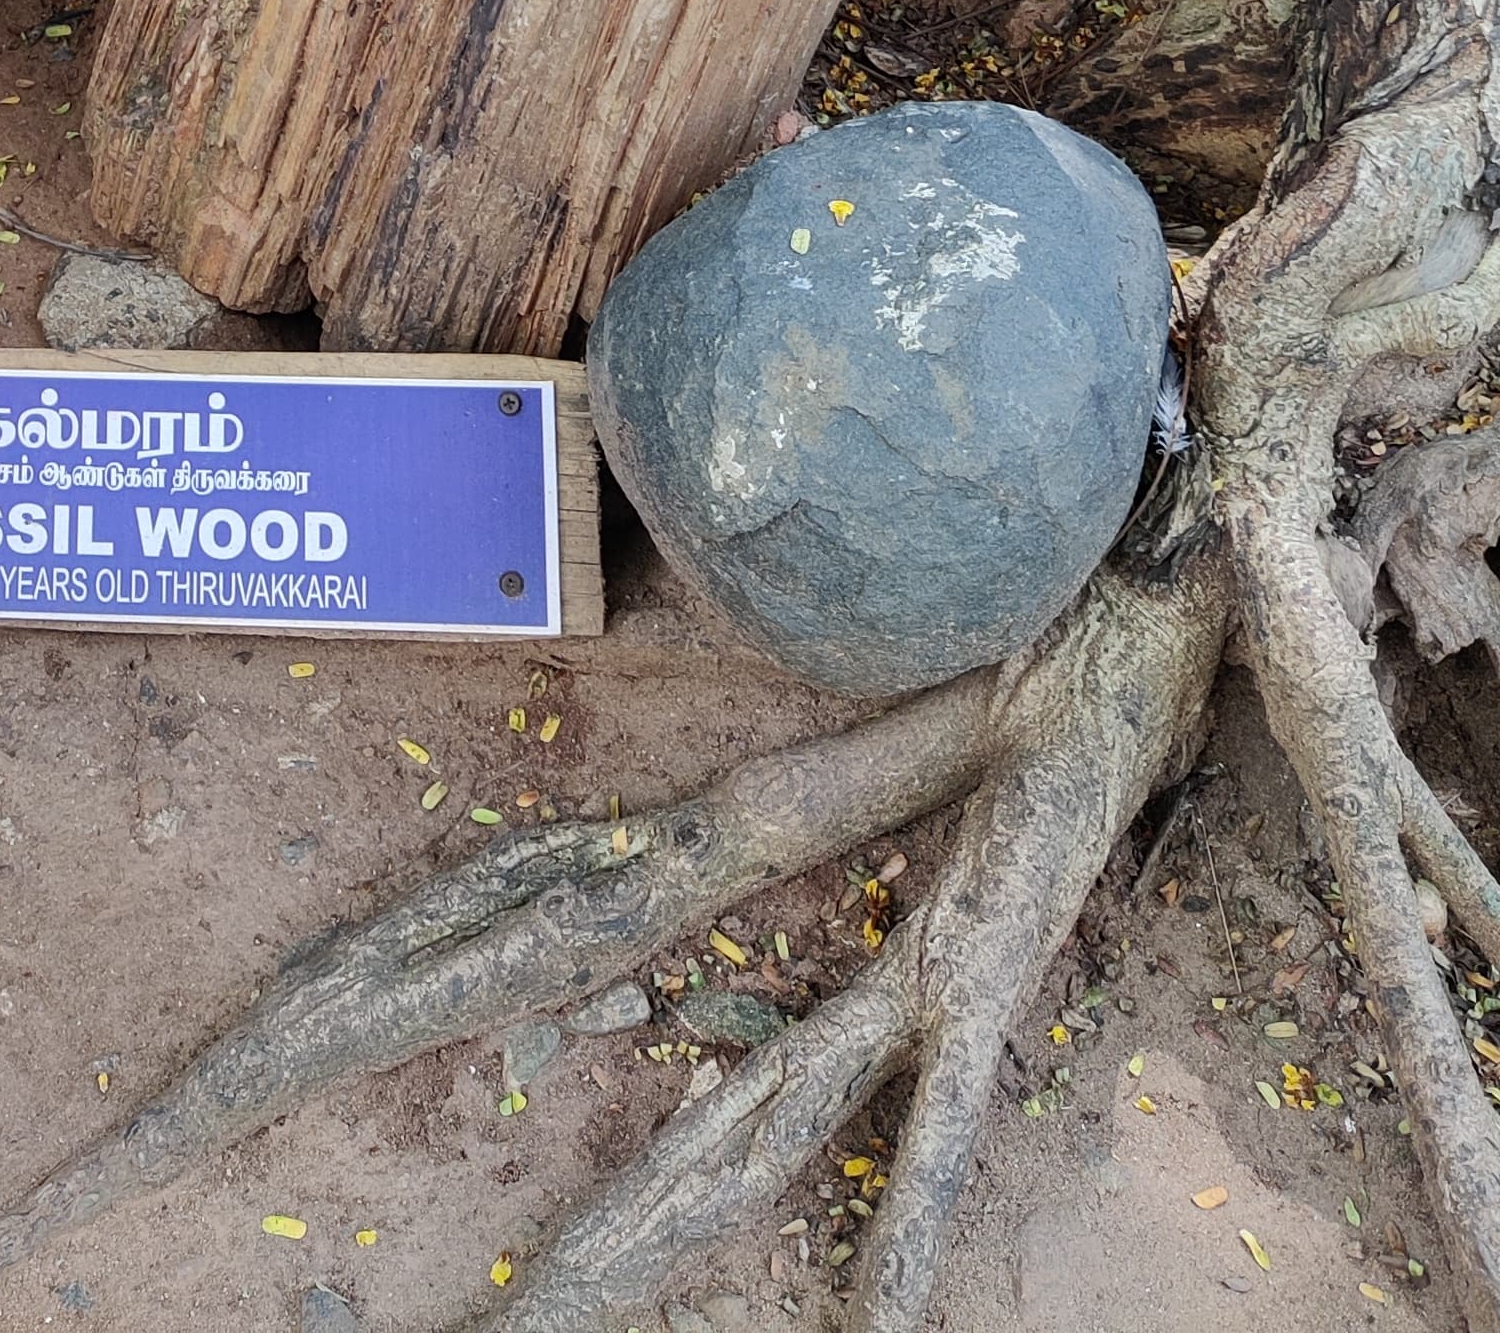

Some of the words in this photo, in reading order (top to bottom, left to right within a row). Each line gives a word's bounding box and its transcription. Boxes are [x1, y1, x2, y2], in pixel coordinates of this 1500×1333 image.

[38, 456, 167, 492] ஆண்டுகள்
[170, 460, 311, 496] திருவக்கரை
[135, 506, 348, 562] WOOD
[0, 565, 88, 602] YEARS
[95, 568, 149, 604] OLD
[155, 570, 367, 610] THIRUVAKKARAI
